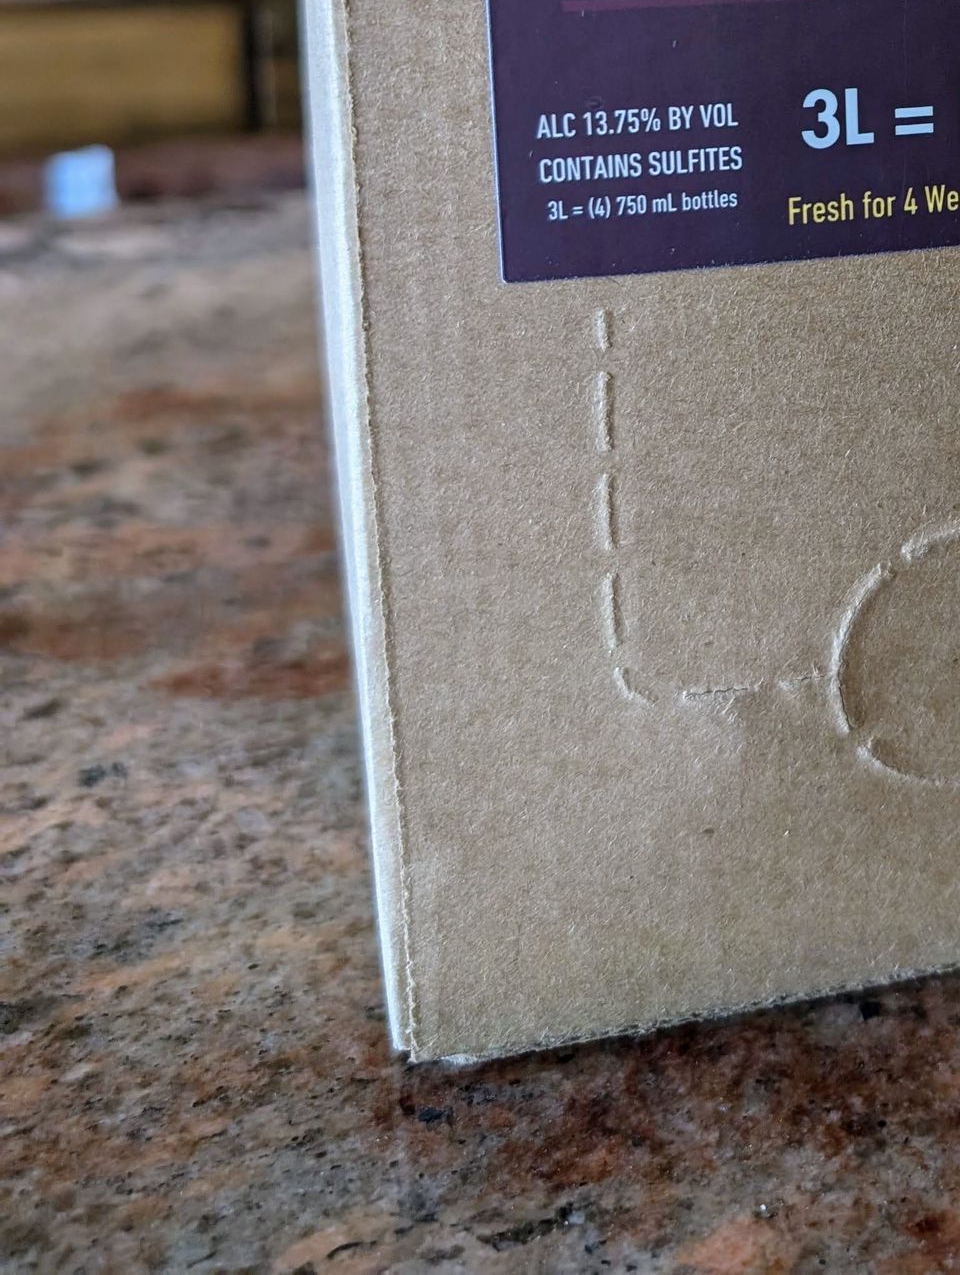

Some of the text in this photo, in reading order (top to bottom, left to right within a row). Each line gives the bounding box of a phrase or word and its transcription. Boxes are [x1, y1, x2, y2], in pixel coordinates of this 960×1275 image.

[537, 103, 738, 138] ALC 13.75% BY VOL
[802, 88, 933, 149] 3L =
[540, 147, 742, 183] CONTAINS SULFITES
[548, 201, 568, 220] 3L
[589, 197, 610, 219] (4)
[616, 195, 646, 215] 750
[653, 193, 677, 212] mL
[682, 190, 737, 210] bottles
[789, 193, 853, 225] Fresh
[863, 191, 896, 218] for
[904, 188, 917, 214] 4
